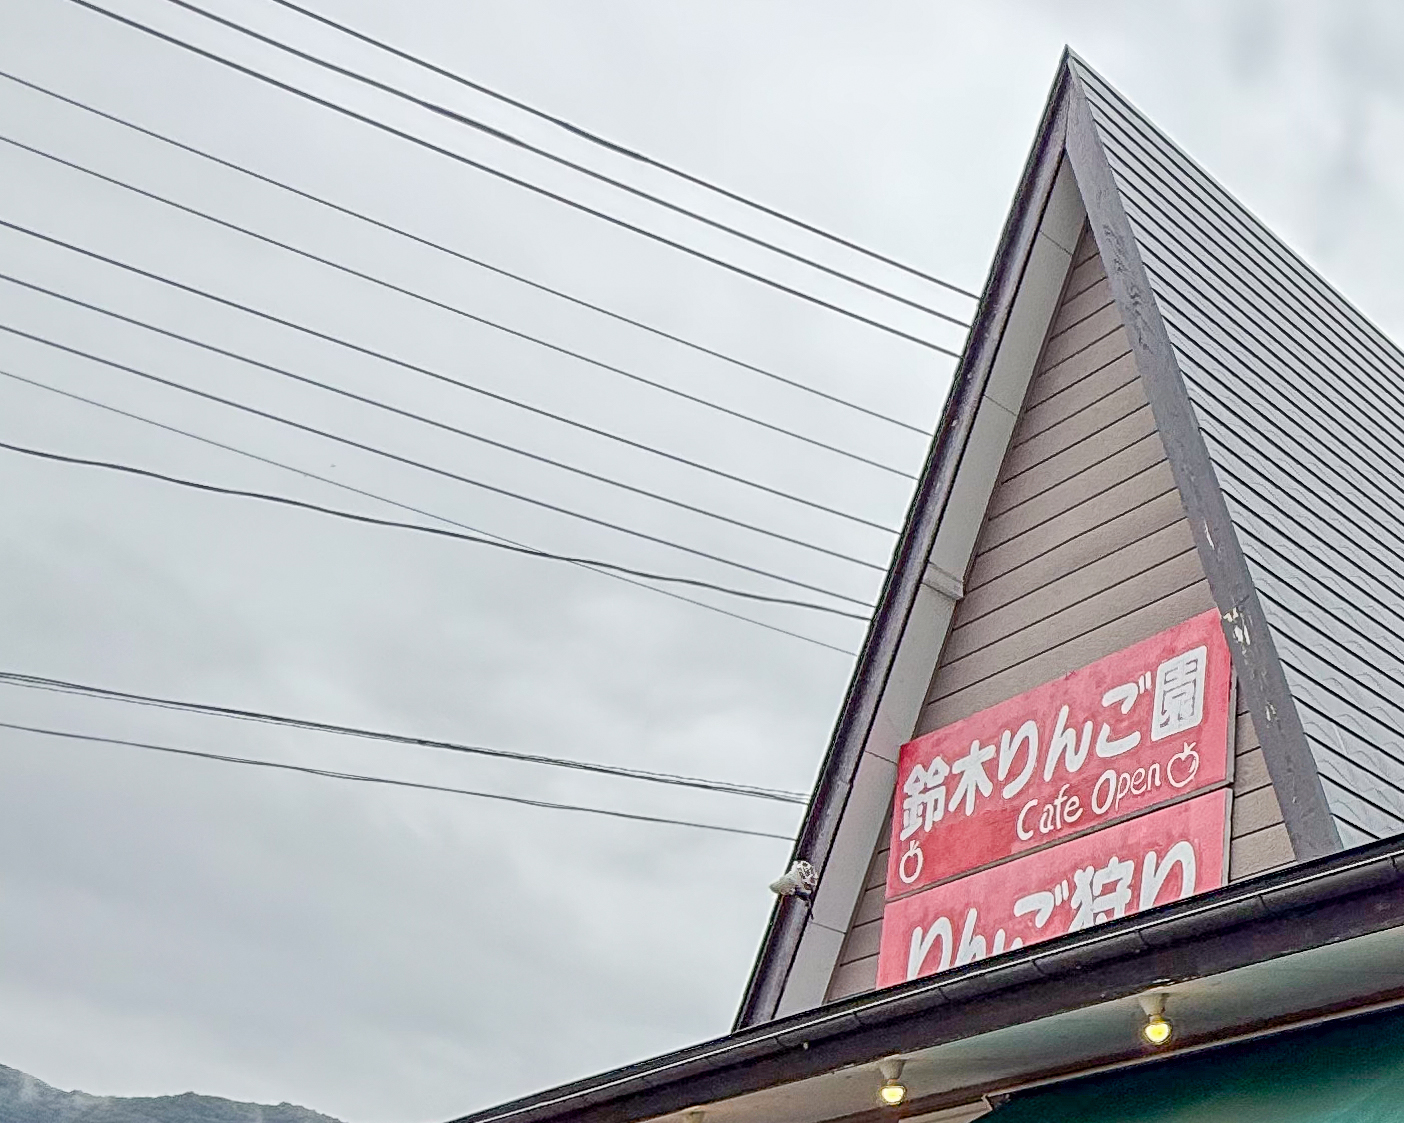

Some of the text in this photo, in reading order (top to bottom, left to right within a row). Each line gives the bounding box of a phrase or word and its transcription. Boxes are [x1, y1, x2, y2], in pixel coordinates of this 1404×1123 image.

[899, 645, 1208, 842] 鈴木りんご園
[1016, 760, 1161, 841] Cafe Open
